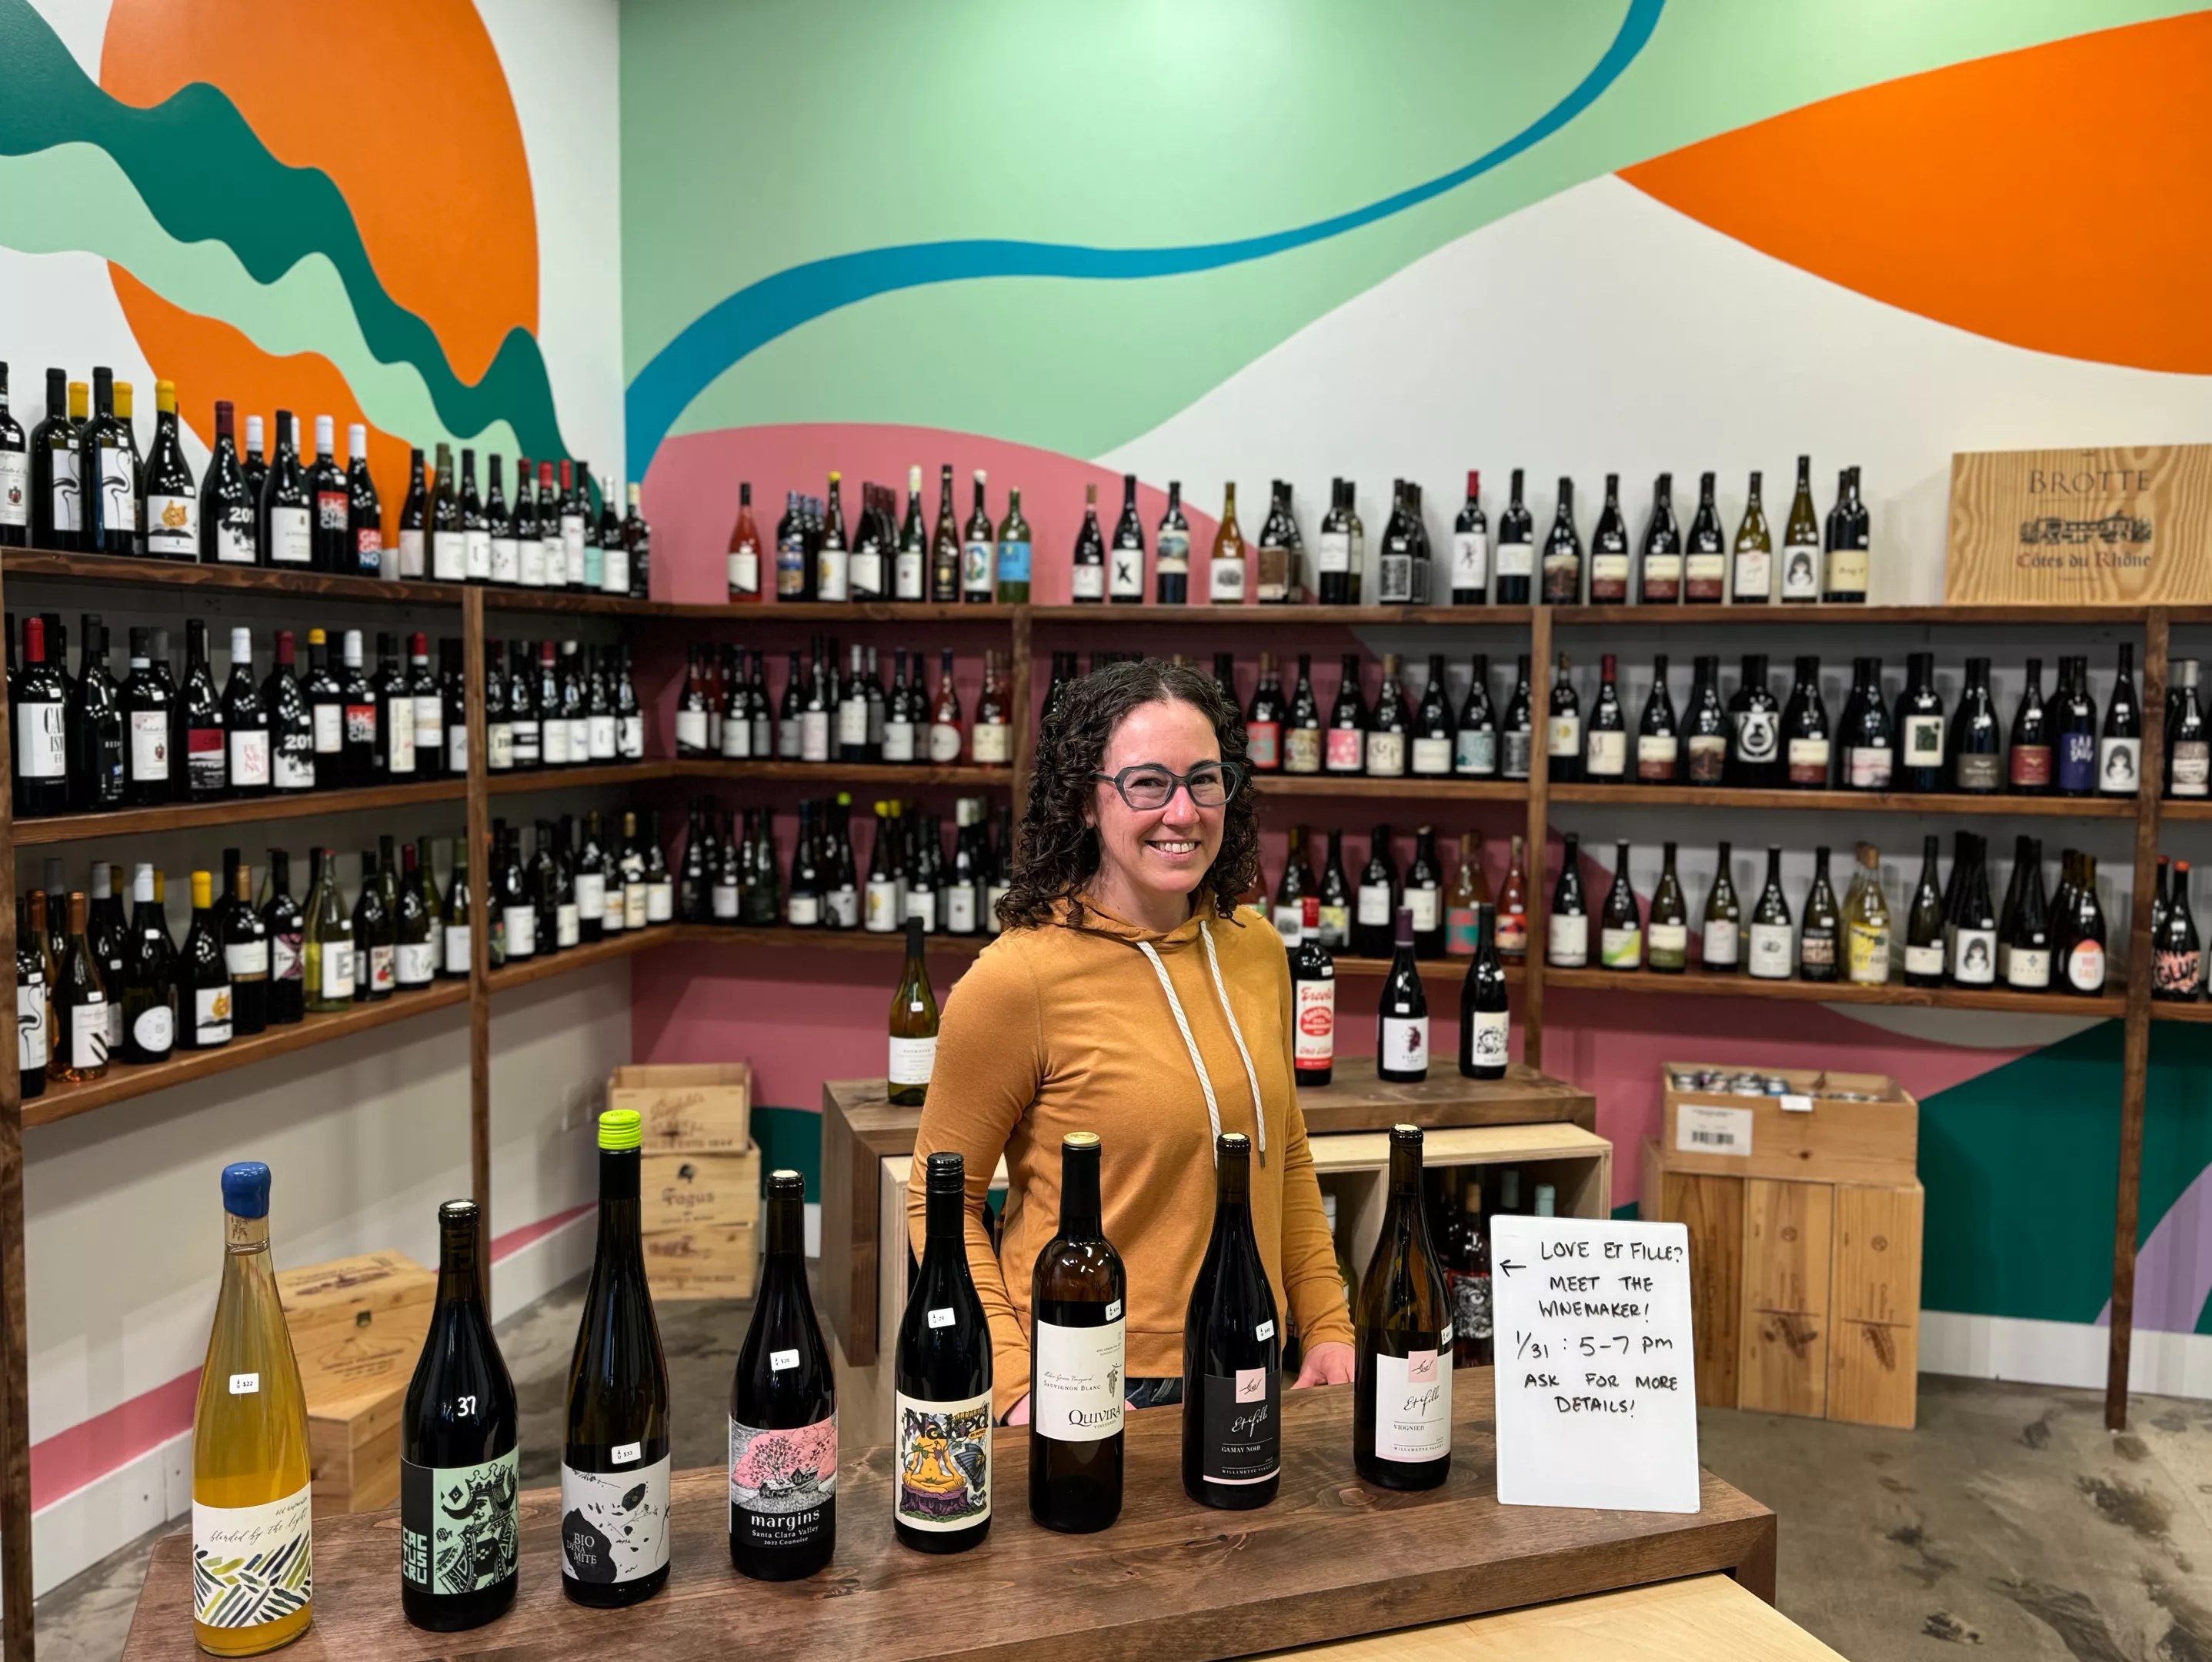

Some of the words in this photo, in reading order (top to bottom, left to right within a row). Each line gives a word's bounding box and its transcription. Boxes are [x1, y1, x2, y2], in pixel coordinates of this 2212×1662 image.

[2030, 469, 2150, 494] BROTTE
[2016, 551, 2064, 568] Côtes
[2068, 552, 2089, 568] du
[2095, 550, 2152, 569] Rhône
[1540, 1241, 1590, 1260] LOVE
[1603, 1243, 1624, 1259] ET
[1630, 1242, 1683, 1263] FILLE?
[1550, 1276, 1600, 1293] MEET
[1618, 1276, 1654, 1293] THE
[1539, 1300, 1650, 1323] WINEMAKER!
[1516, 1330, 1549, 1360] 1/31
[1579, 1335, 1630, 1357] 5-7
[1642, 1337, 1673, 1355] pm
[1043, 1380, 1078, 1390] SAUVIGNON
[1523, 1373, 1560, 1388] ASK
[1585, 1373, 1620, 1389] FOR
[1635, 1374, 1678, 1391] MORE
[458, 1395, 476, 1417] 37
[1069, 1404, 1121, 1427] QUIVIRA
[1554, 1396, 1635, 1418] DETAILS!
[1221, 1445, 1245, 1453] GAMAY
[1246, 1444, 1261, 1453] NOIR
[751, 1510, 820, 1531] margins
[573, 1532, 596, 1548] BIO
[752, 1530, 772, 1538] Santa
[798, 1525, 819, 1536] Valley
[402, 1544, 428, 1567] TUS
[573, 1551, 598, 1564] MITE
[402, 1559, 428, 1584] CRU
